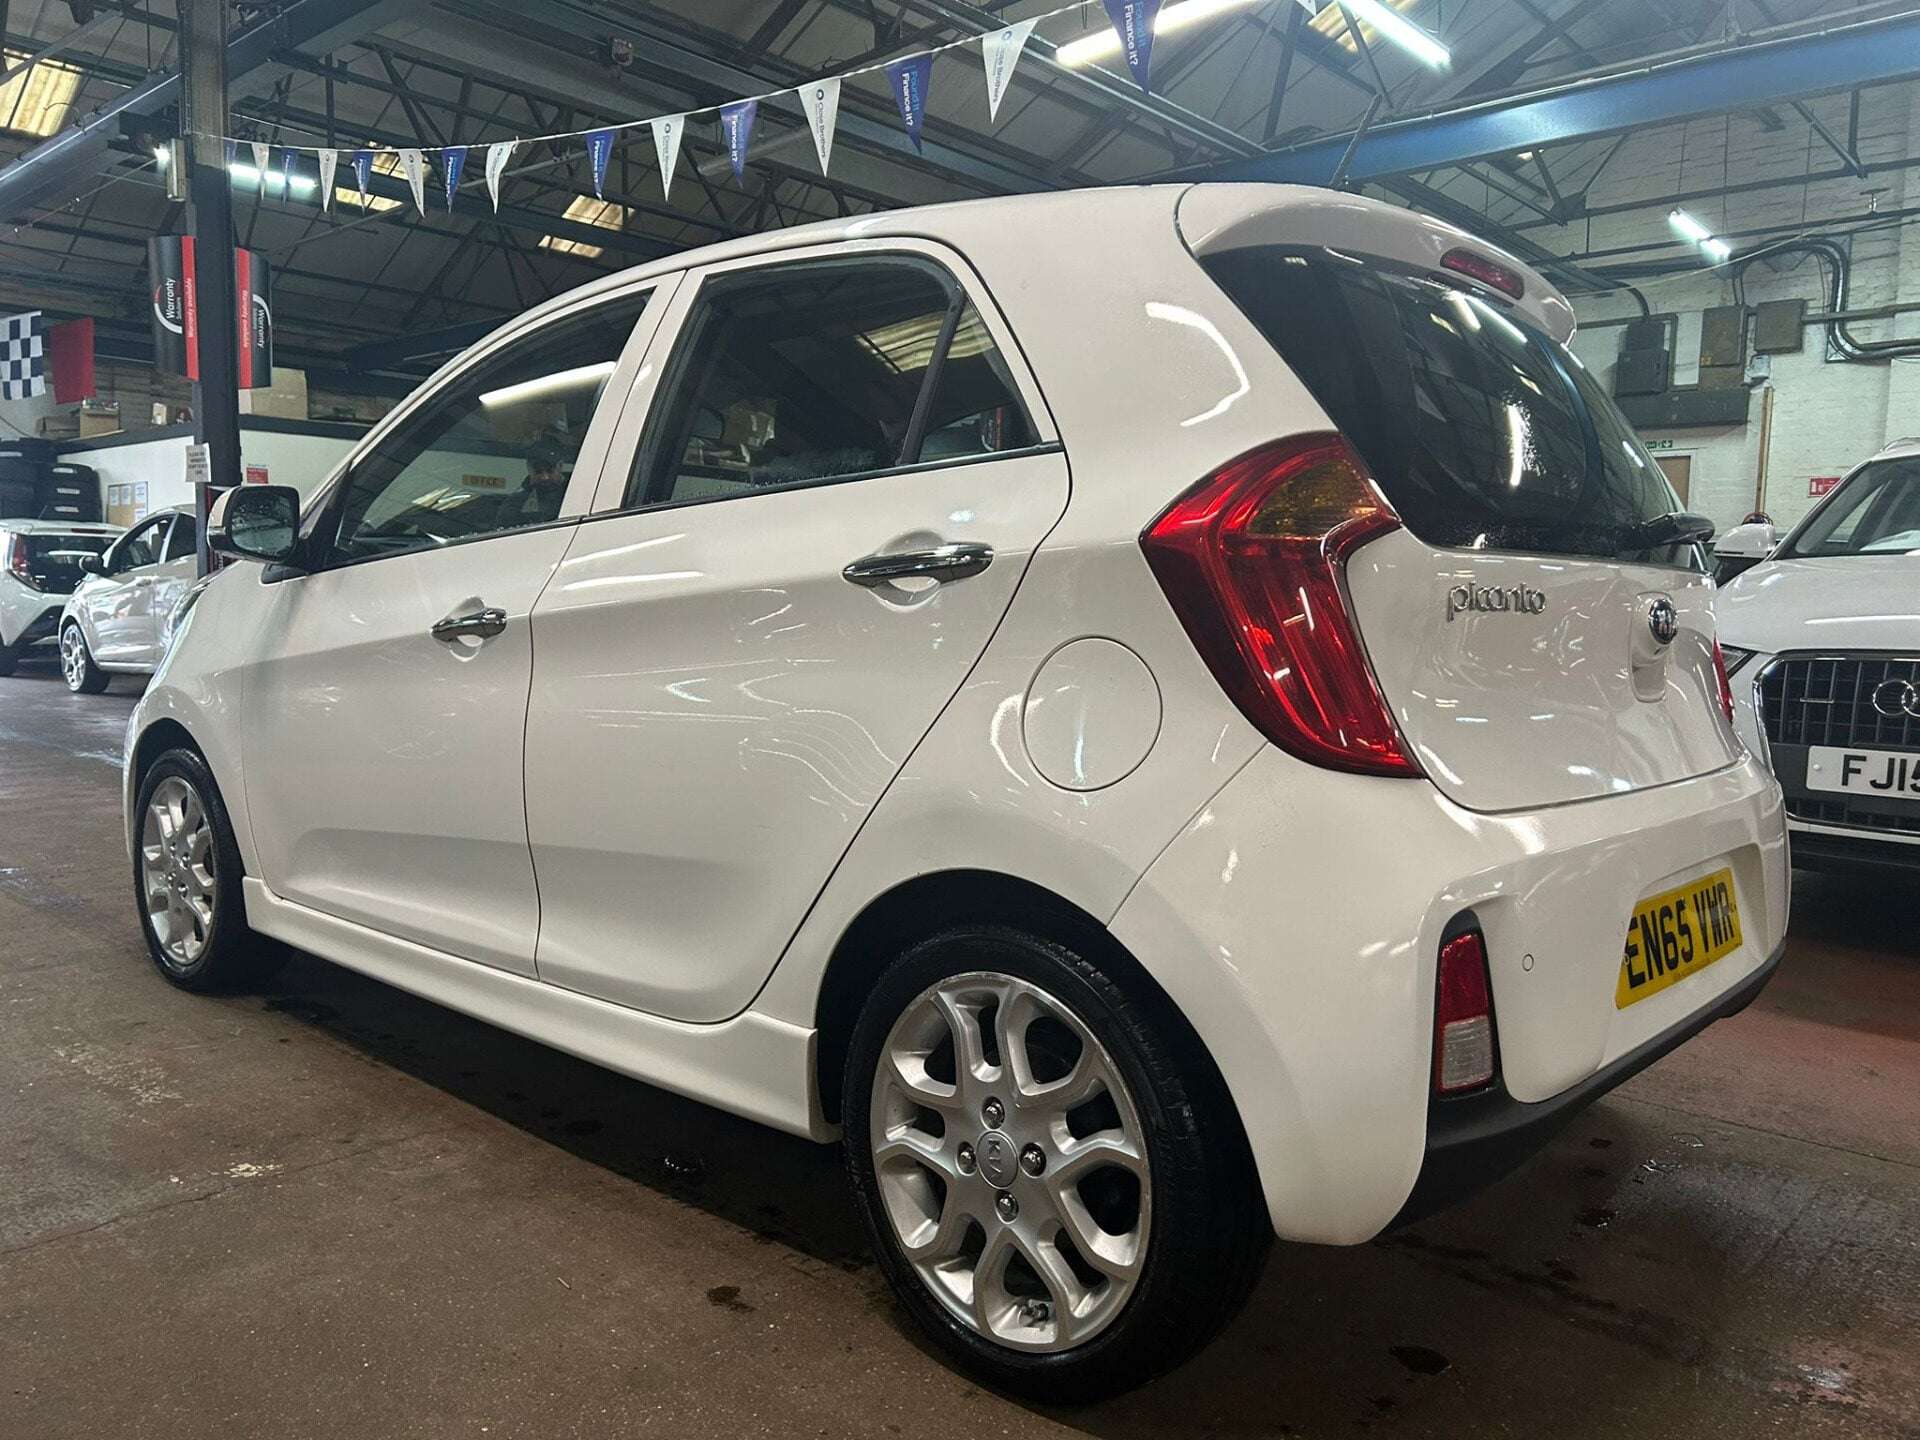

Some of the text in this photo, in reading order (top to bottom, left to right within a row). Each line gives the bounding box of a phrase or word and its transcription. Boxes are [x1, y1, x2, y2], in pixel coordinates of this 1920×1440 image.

[1124, 4, 1138, 66] Finance it?
[902, 72, 914, 127] Finance it?
[165, 277, 176, 319] Warranty
[257, 308, 265, 349] Warranty
[1447, 580, 1547, 622] picanto
[1623, 899, 1694, 989] EN65
